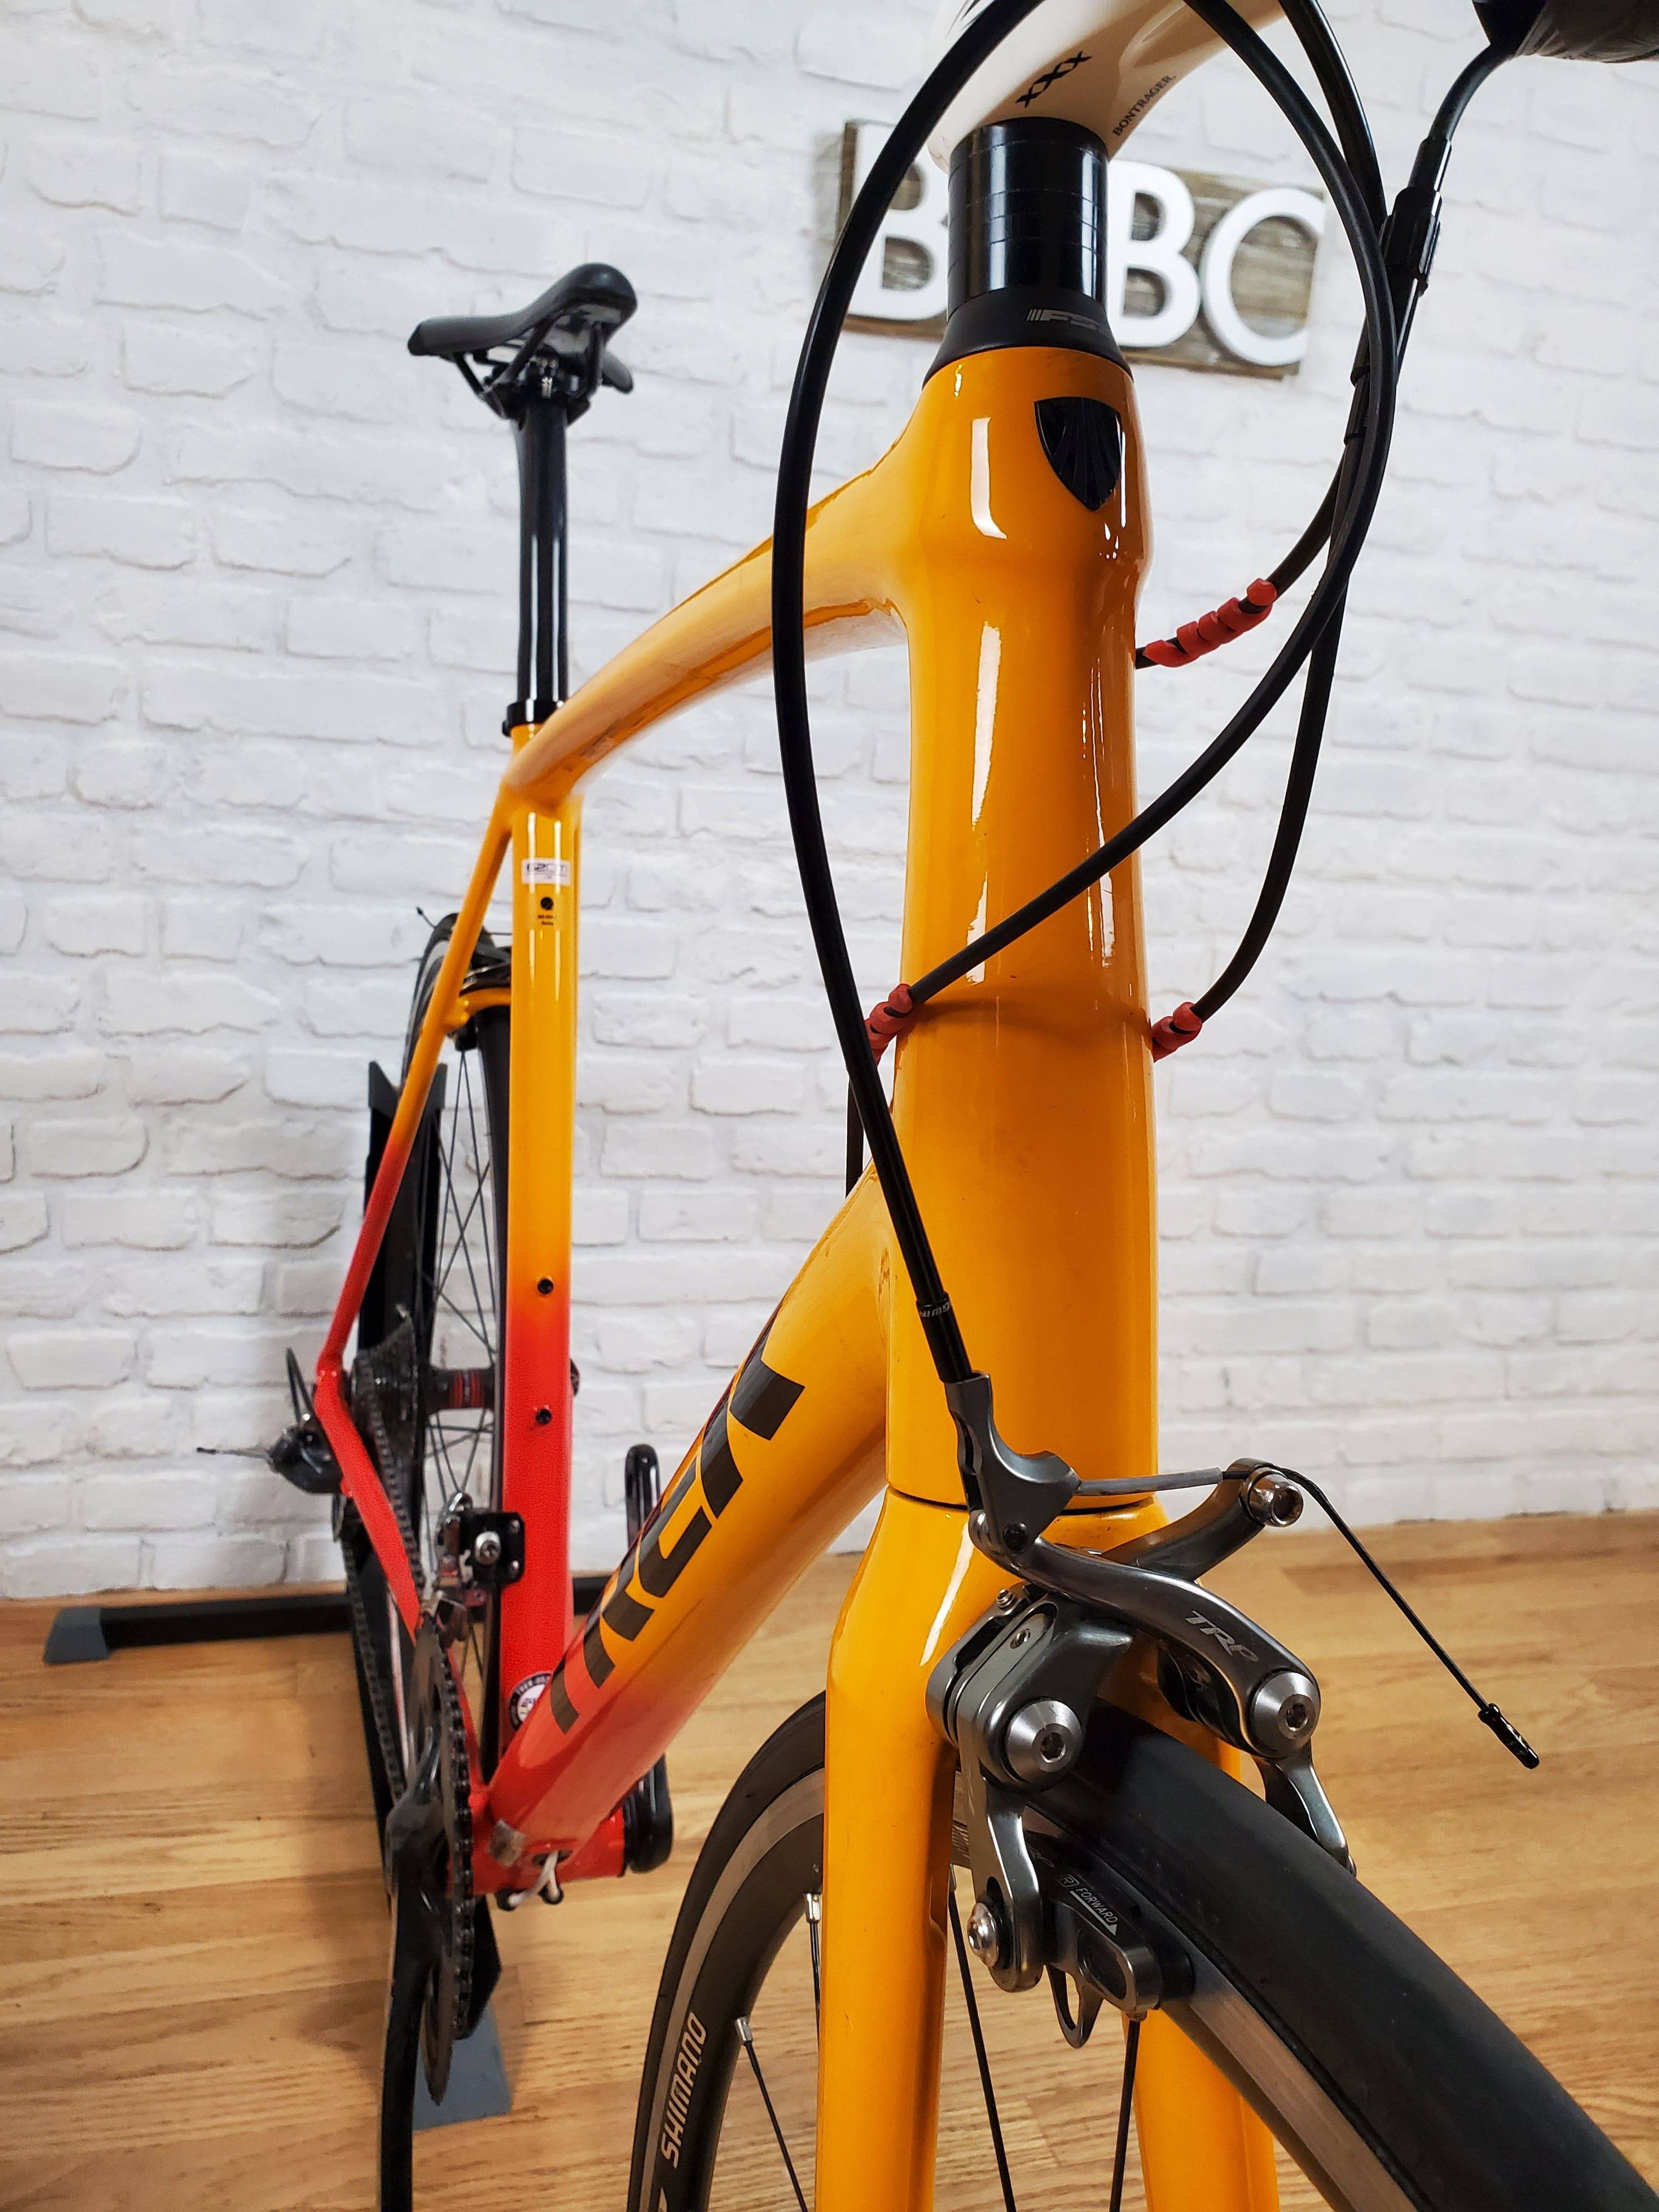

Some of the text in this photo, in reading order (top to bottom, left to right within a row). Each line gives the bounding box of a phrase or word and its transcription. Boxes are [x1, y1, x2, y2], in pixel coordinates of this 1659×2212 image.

[1015, 50, 1092, 108] XXX
[1185, 1610, 1259, 1662] TRP
[1076, 1888, 1118, 1923] FORWARD
[661, 2012, 707, 2169] SHIMANO
